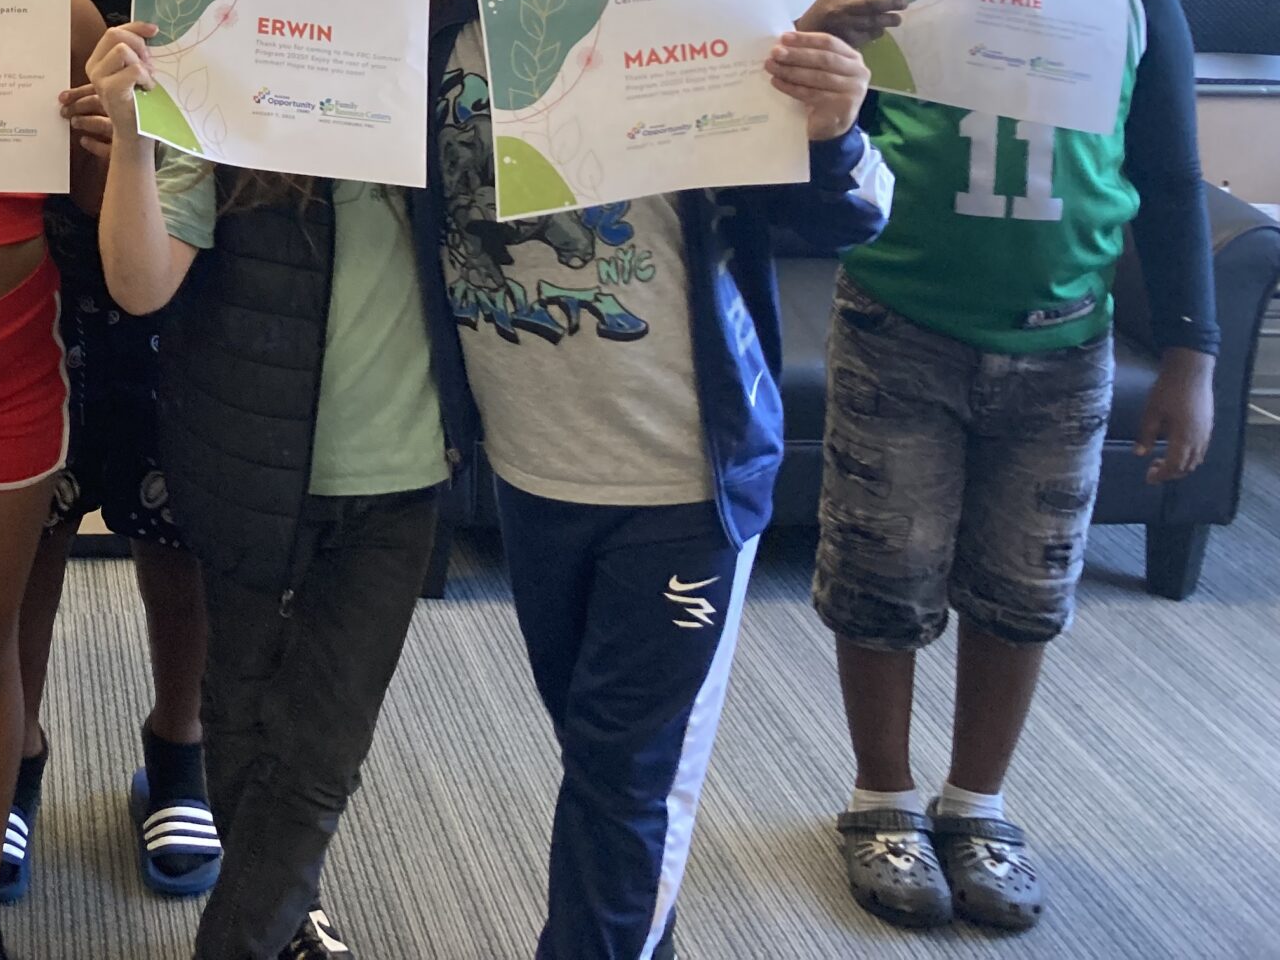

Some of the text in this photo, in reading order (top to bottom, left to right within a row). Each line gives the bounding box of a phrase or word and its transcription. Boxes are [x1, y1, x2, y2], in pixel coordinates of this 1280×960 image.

[257, 17, 333, 43] ERWIN
[623, 38, 729, 70] MAXIMO
[267, 97, 315, 110] Opportunity
[954, 111, 1063, 220] 11
